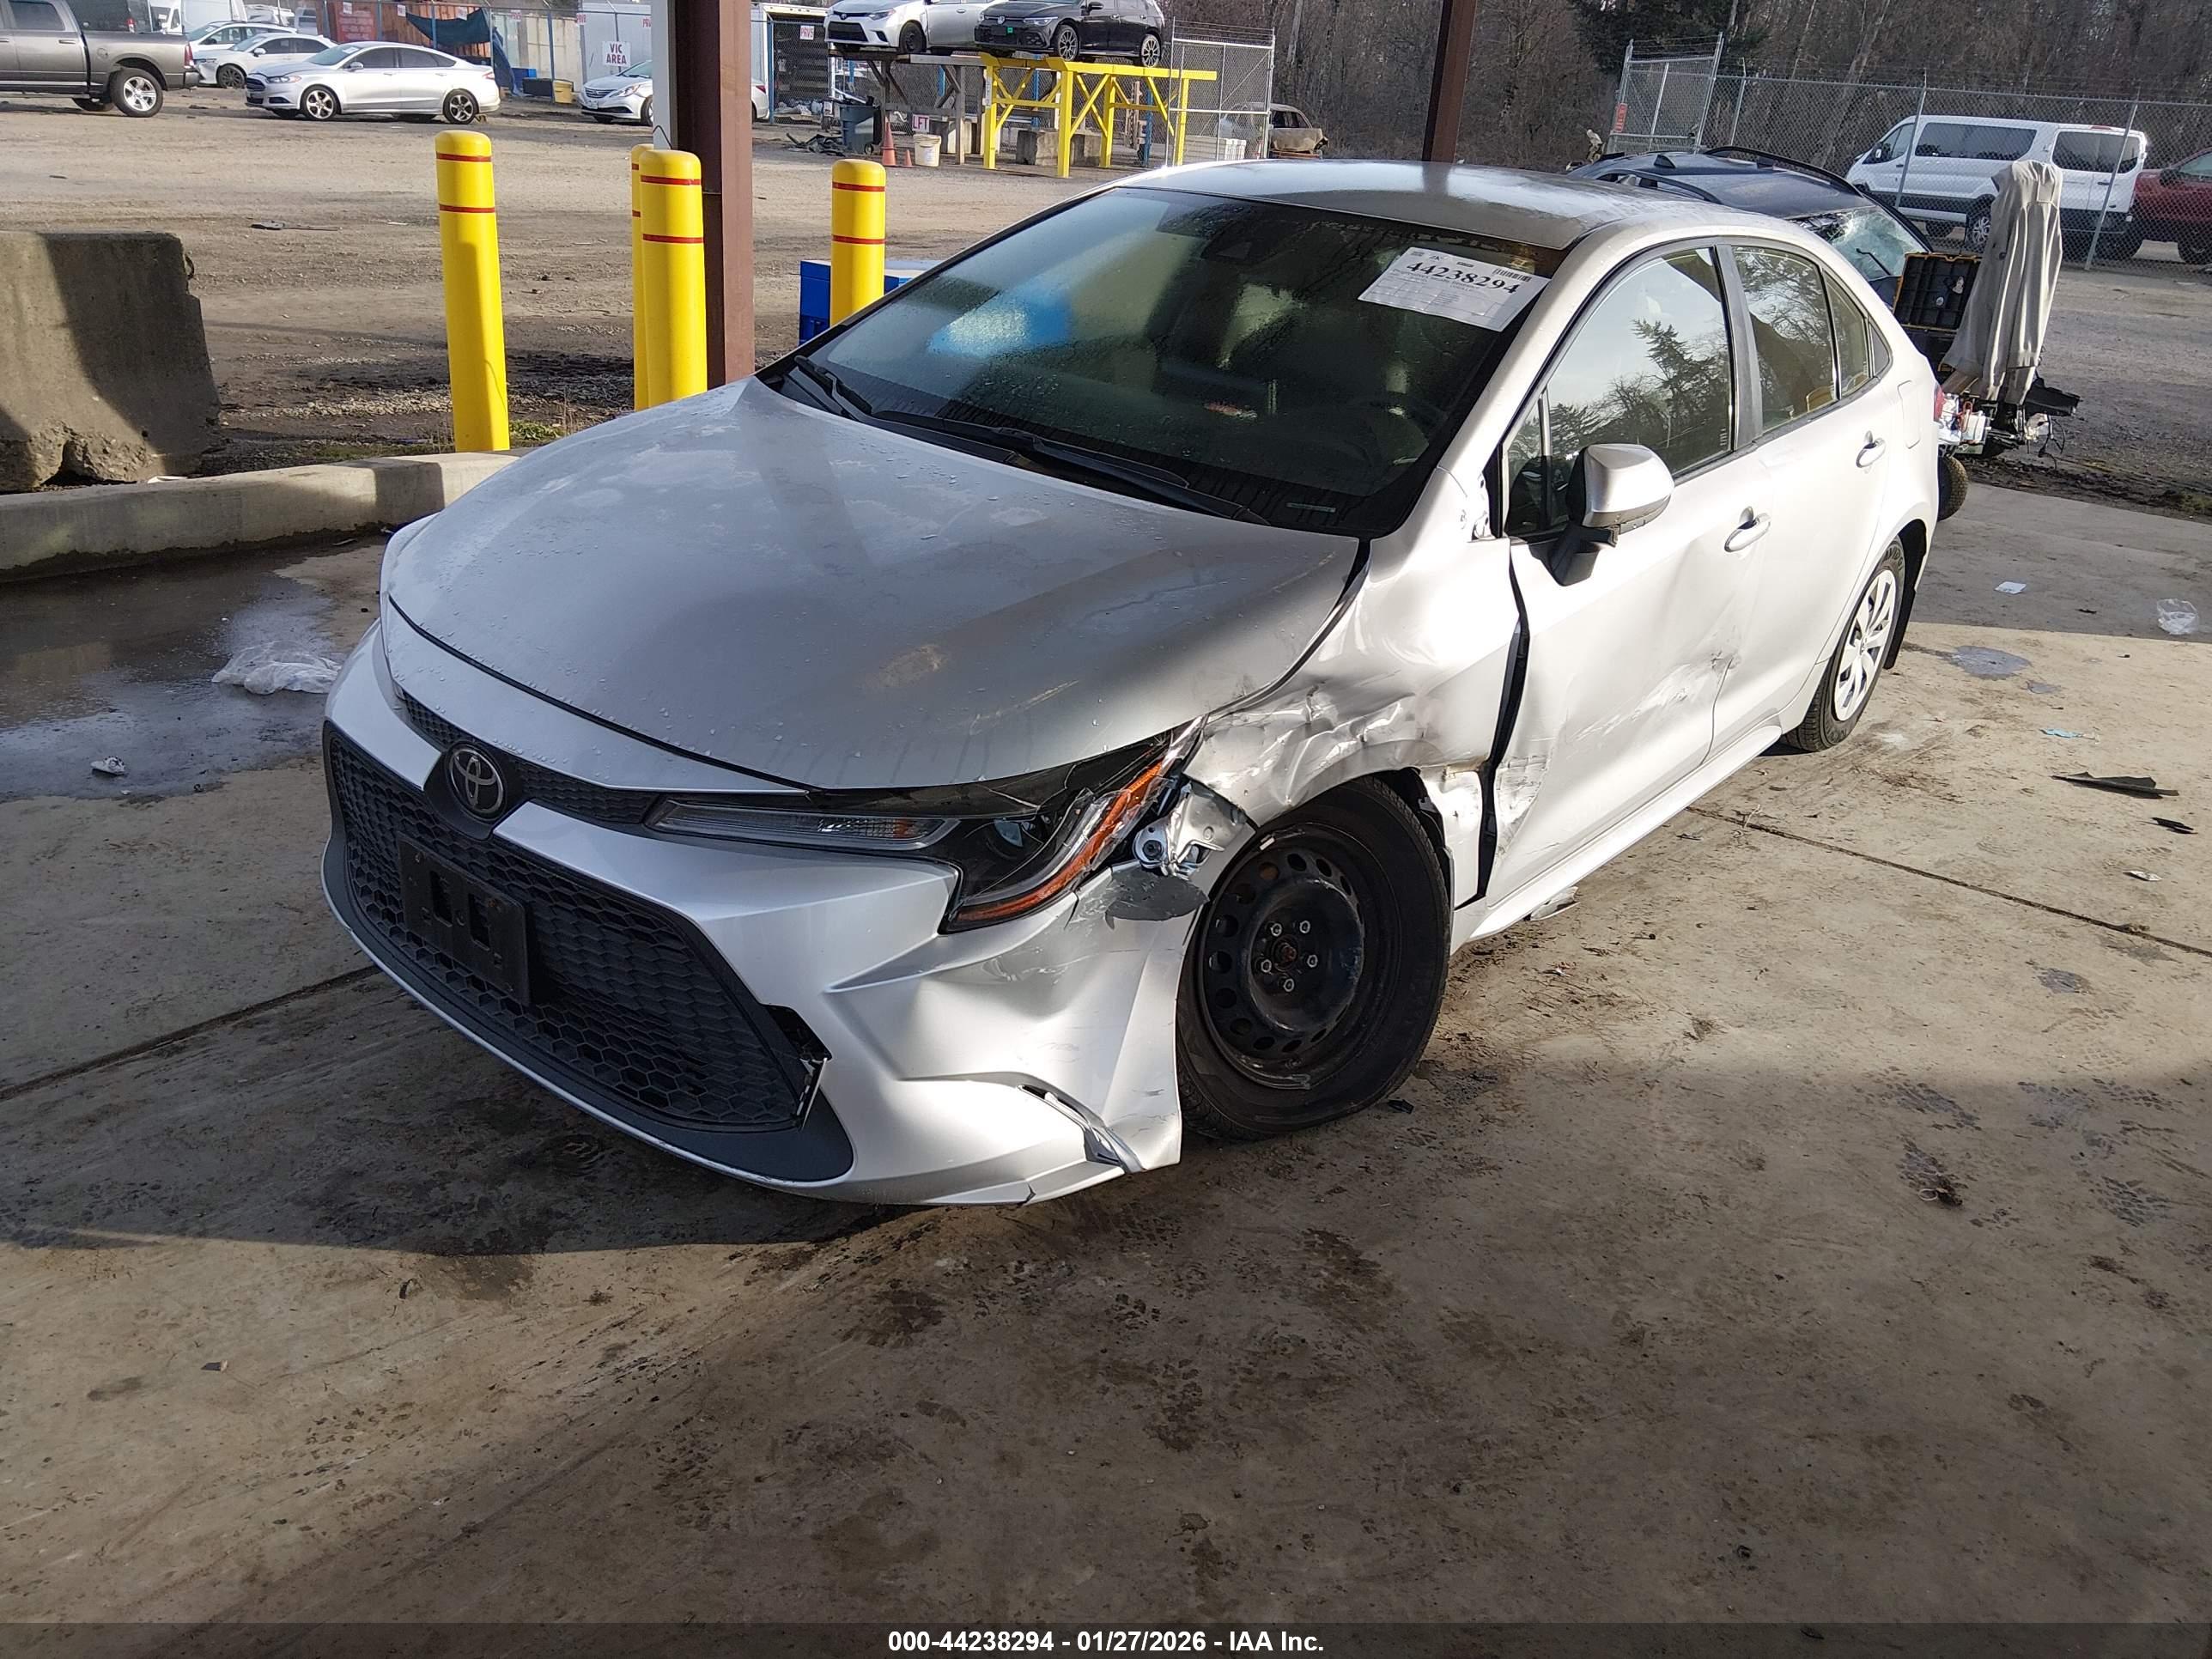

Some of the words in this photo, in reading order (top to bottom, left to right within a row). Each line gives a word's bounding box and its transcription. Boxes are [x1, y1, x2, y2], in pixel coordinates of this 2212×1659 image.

[610, 43, 623, 54] VIC
[605, 53, 627, 64] AREA
[1406, 261, 1521, 294] 44238294
